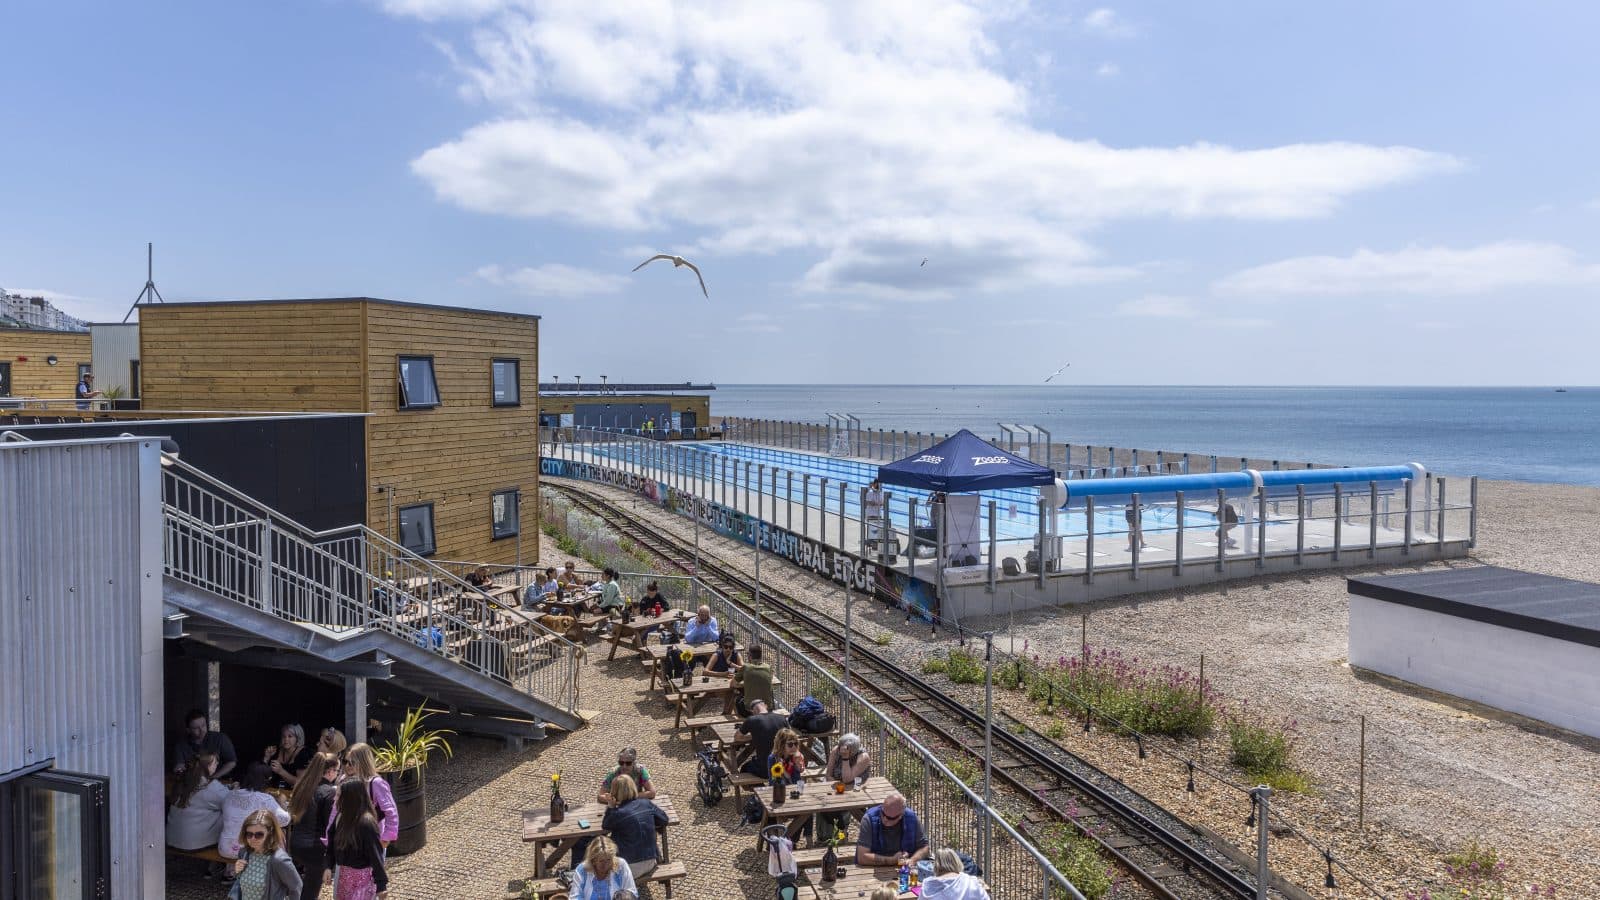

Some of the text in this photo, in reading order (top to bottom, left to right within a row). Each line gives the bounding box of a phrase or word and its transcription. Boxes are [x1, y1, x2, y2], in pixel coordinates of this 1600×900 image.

[541, 459, 564, 475] CITY
[565, 461, 587, 479] WITH
[588, 463, 601, 480] THE
[971, 456, 1010, 467] ZOGGS
[771, 528, 830, 575] NATURAL
[833, 551, 877, 594] EDGE
